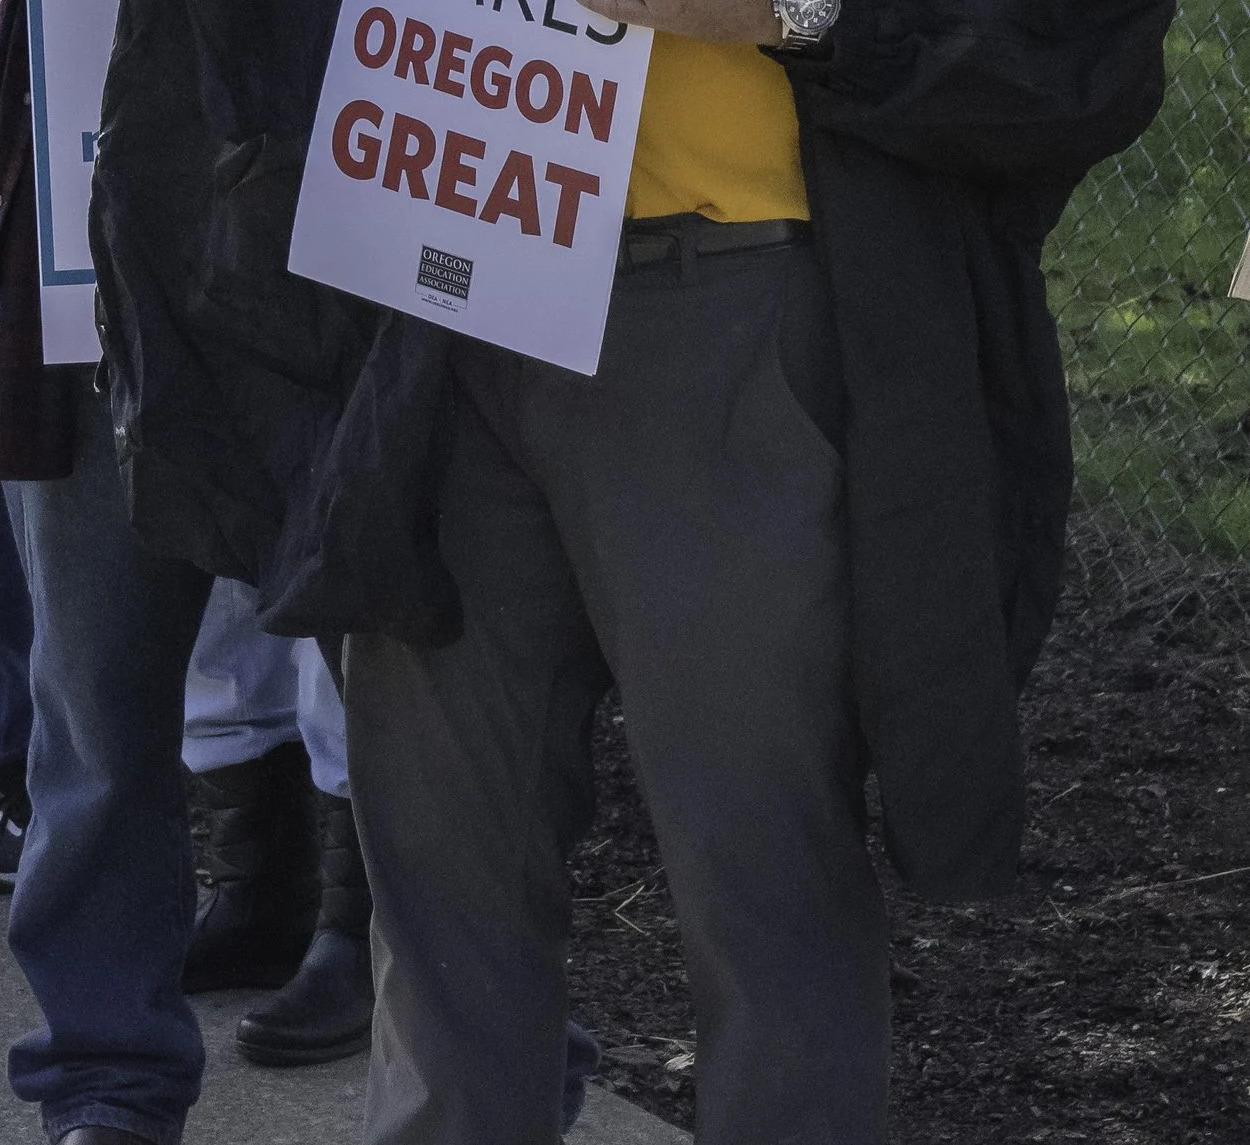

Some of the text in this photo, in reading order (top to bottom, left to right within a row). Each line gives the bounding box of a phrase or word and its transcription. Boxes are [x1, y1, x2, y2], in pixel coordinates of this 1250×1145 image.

[353, 6, 618, 143] OREGON
[331, 99, 600, 249] GREAT
[423, 249, 471, 273] OREGON
[418, 276, 467, 297] ASSOCIATION
[421, 263, 469, 286] EDUCATION
